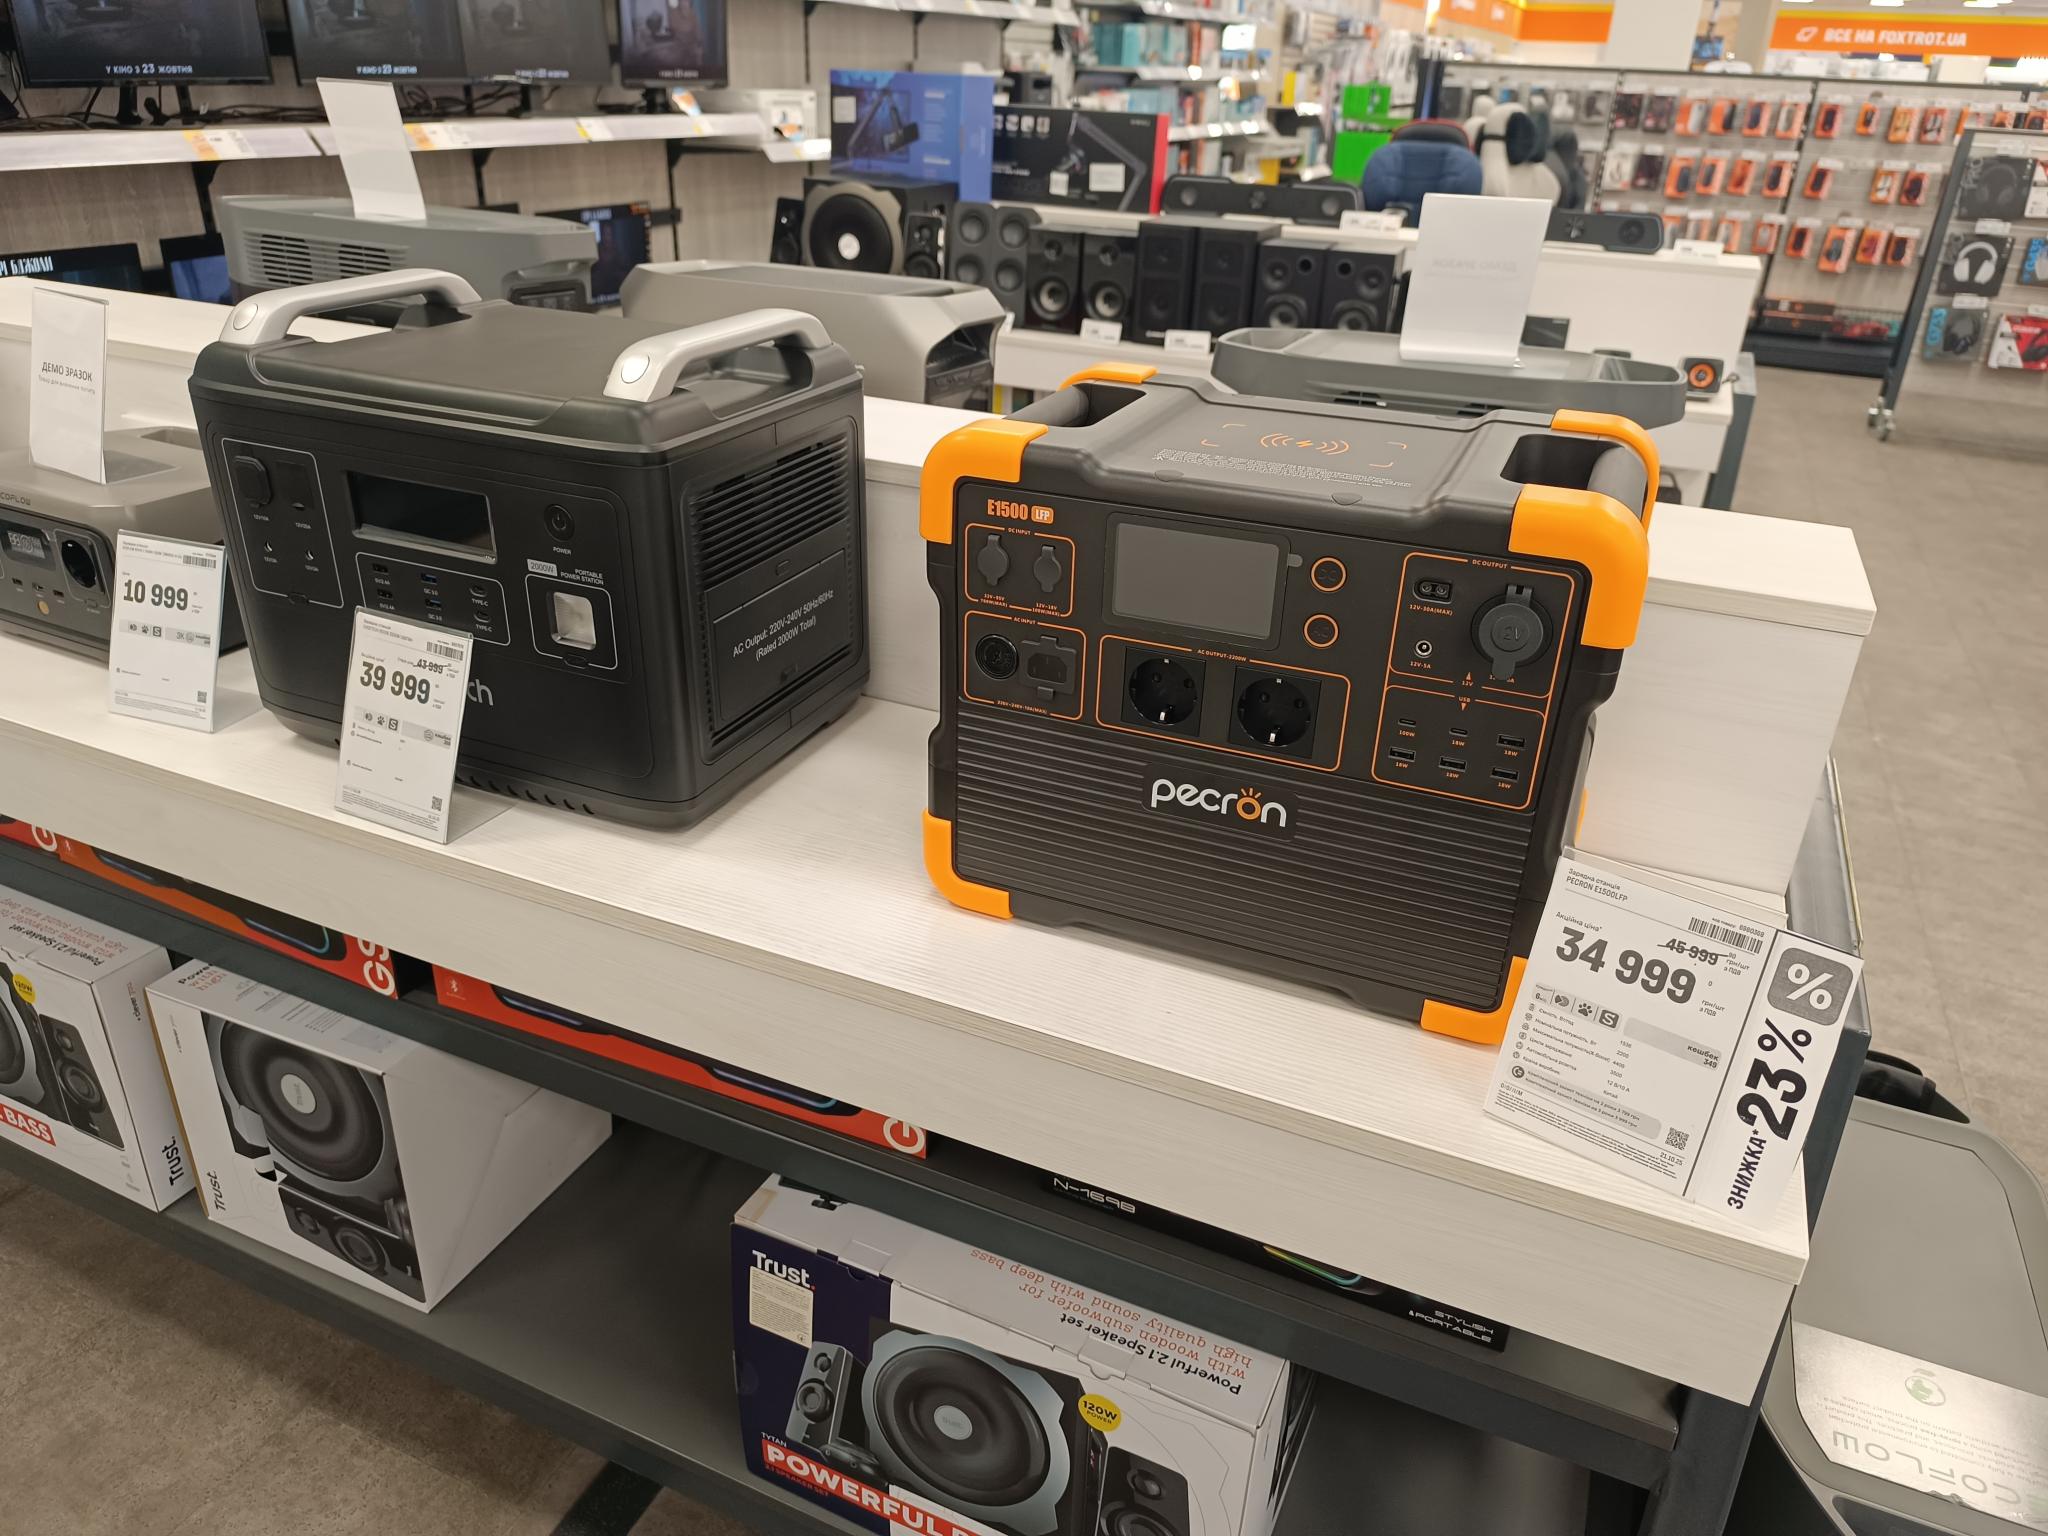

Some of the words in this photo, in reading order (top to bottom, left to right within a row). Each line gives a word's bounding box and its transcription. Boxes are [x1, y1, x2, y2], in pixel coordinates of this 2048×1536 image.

[1824, 28, 1853, 43] ВСЕ
[1855, 29, 1876, 44] НА
[1878, 30, 1967, 47] FOXTROT.UA
[113, 65, 133, 74] КІНО
[142, 63, 154, 74] 23
[42, 362, 64, 376] ДЕМО
[65, 367, 93, 382] ЗРАЗОК
[987, 499, 1028, 520] E1500
[1035, 509, 1049, 520] LFP
[553, 546, 571, 555] POWER
[530, 561, 555, 574] 2000W
[575, 568, 604, 580] PORTABLE
[1481, 560, 1507, 569] OUTPUT
[560, 571, 580, 582] POWER
[581, 574, 604, 585] STATION
[124, 579, 146, 604] 10
[151, 583, 188, 611] 999
[472, 598, 489, 607] TYPE-C
[476, 624, 492, 632] TYPE-C
[733, 642, 744, 657] AC
[744, 629, 768, 650] Output:
[769, 606, 802, 635] 220V-240V
[803, 590, 834, 615] 50Hz/60Hz
[756, 640, 777, 661] (Rated
[778, 626, 799, 647] 2000W
[800, 616, 816, 632] Total)
[417, 659, 428, 670] 43
[428, 663, 443, 674] 999
[360, 661, 386, 691] 39
[391, 670, 430, 704] 999
[1151, 778, 1287, 828] pecron
[1566, 876, 1594, 892] PECRON
[1594, 885, 1628, 902] E1500LFP
[1568, 868, 1595, 883] Зарядна
[1596, 878, 1621, 891] станція
[1556, 911, 1584, 927] Акційна
[1666, 938, 1687, 954] 45
[1688, 945, 1719, 966] 999
[1555, 926, 1609, 973] 34
[1615, 949, 1697, 1004] 999
[1726, 959, 1750, 971] грн/шт
[1728, 967, 1742, 976] ПДВ
[1702, 1000, 1725, 1012] грн/шт
[1704, 1007, 1717, 1017] ПДВ
[1687, 1045, 1719, 1062] кешбек
[1703, 1058, 1718, 1069] 349
[1737, 1017, 1812, 1141] 23%
[3, 1106, 52, 1141] BASS
[1660, 1152, 1683, 1166] 21.10.25
[970, 1249, 1005, 1270] bass
[1010, 1263, 1044, 1284] deep
[1019, 1284, 1045, 1300] for
[1050, 1279, 1084, 1300] with
[1048, 1294, 1133, 1334] subwoofer
[1092, 1296, 1141, 1321] sound
[1060, 1312, 1085, 1329] set
[1434, 1310, 1494, 1335] STYLISH
[1085, 1322, 1147, 1355] Speaker
[1146, 1317, 1206, 1348] quality
[1139, 1328, 1200, 1361] wooden
[1147, 1348, 1168, 1365] 2.1
[1213, 1342, 1253, 1369] high
[1171, 1357, 1241, 1396] Powerful
[1208, 1358, 1246, 1380] with
[1083, 1400, 1117, 1420] 120W
[1087, 1410, 1112, 1424] POWER
[761, 1432, 787, 1448] TYTAN
[767, 1443, 944, 1536] POWERFUL
